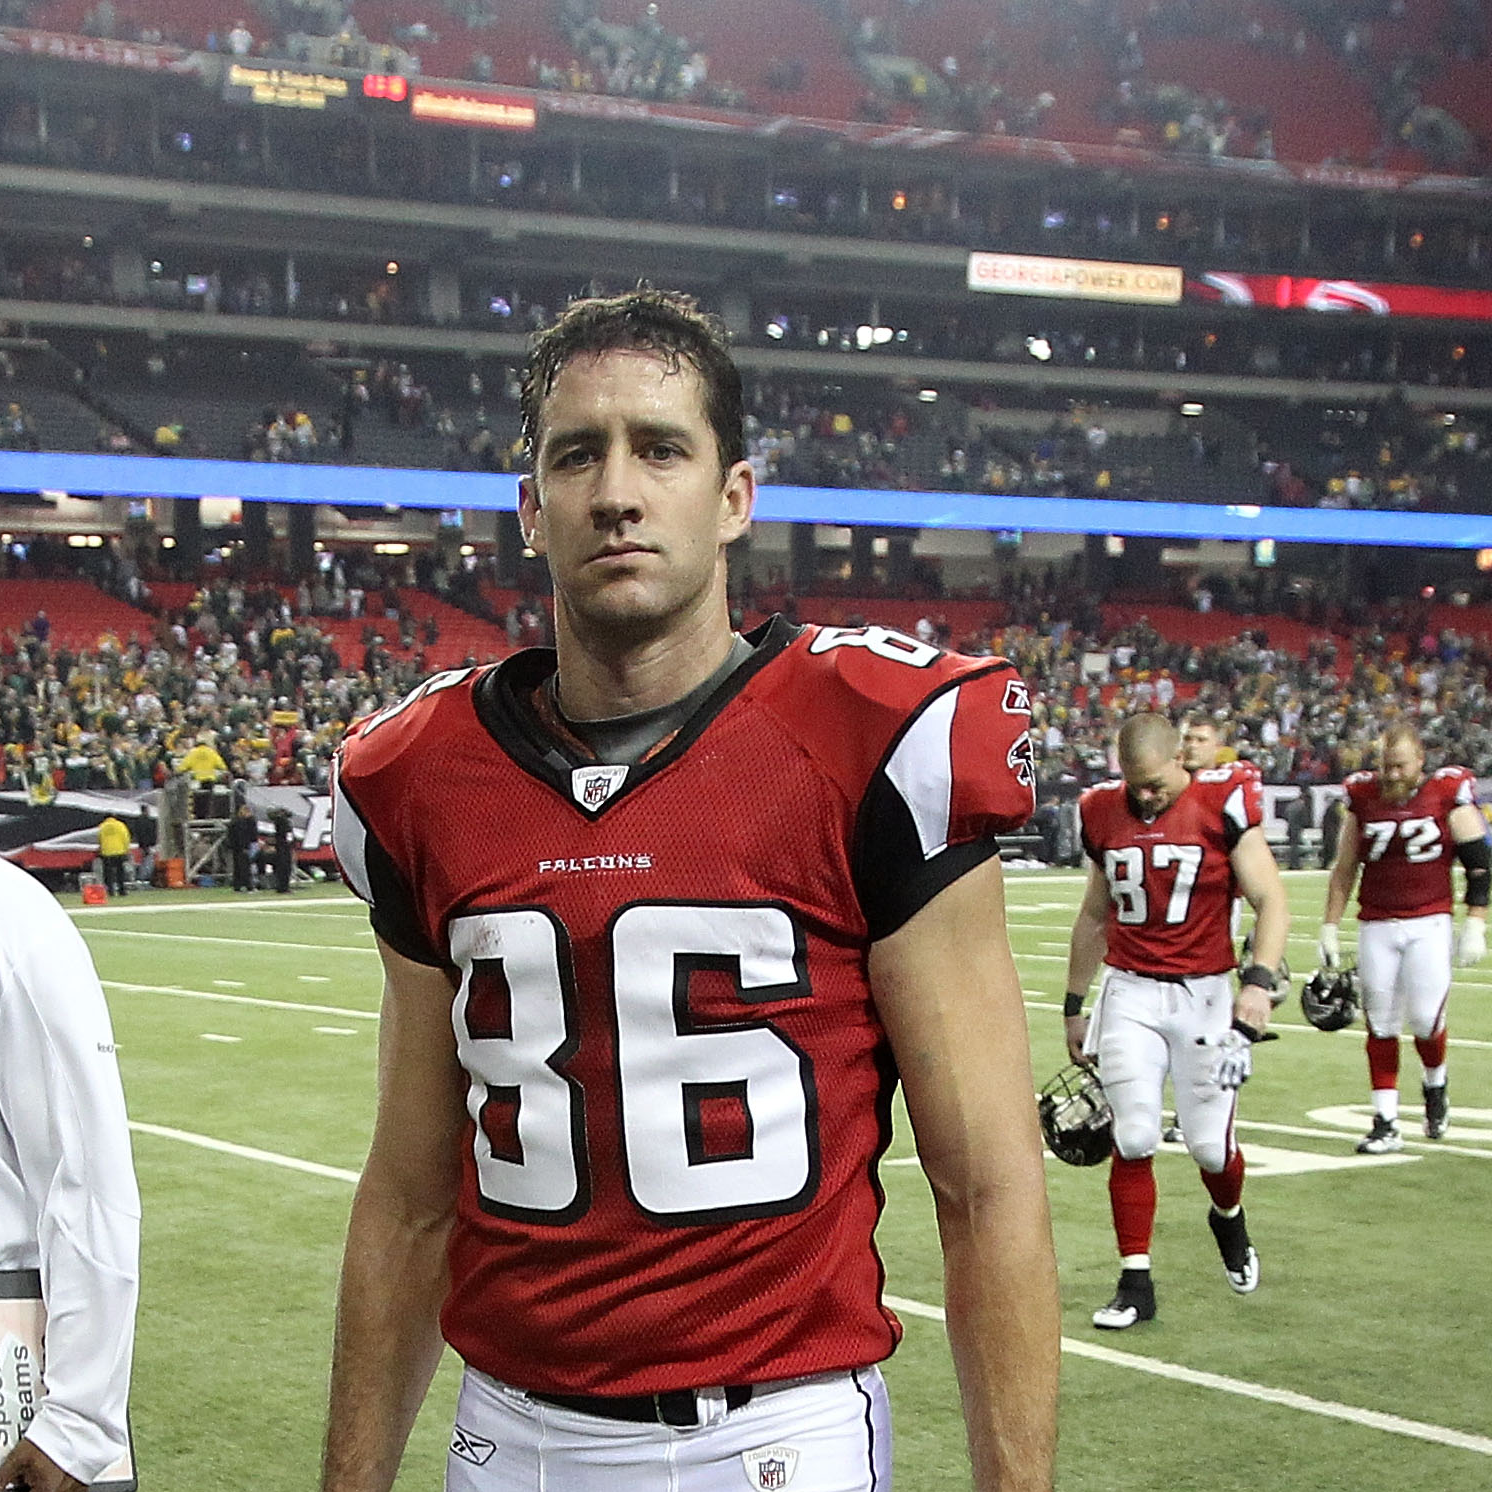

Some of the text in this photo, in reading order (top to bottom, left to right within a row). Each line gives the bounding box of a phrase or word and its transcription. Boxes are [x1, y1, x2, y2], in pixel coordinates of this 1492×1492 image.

[1364, 816, 1443, 864] 72
[538, 855, 653, 874] FALCONS
[1105, 845, 1203, 925] 87
[449, 902, 814, 1221] 86
[761, 1471, 785, 1487] NFL
